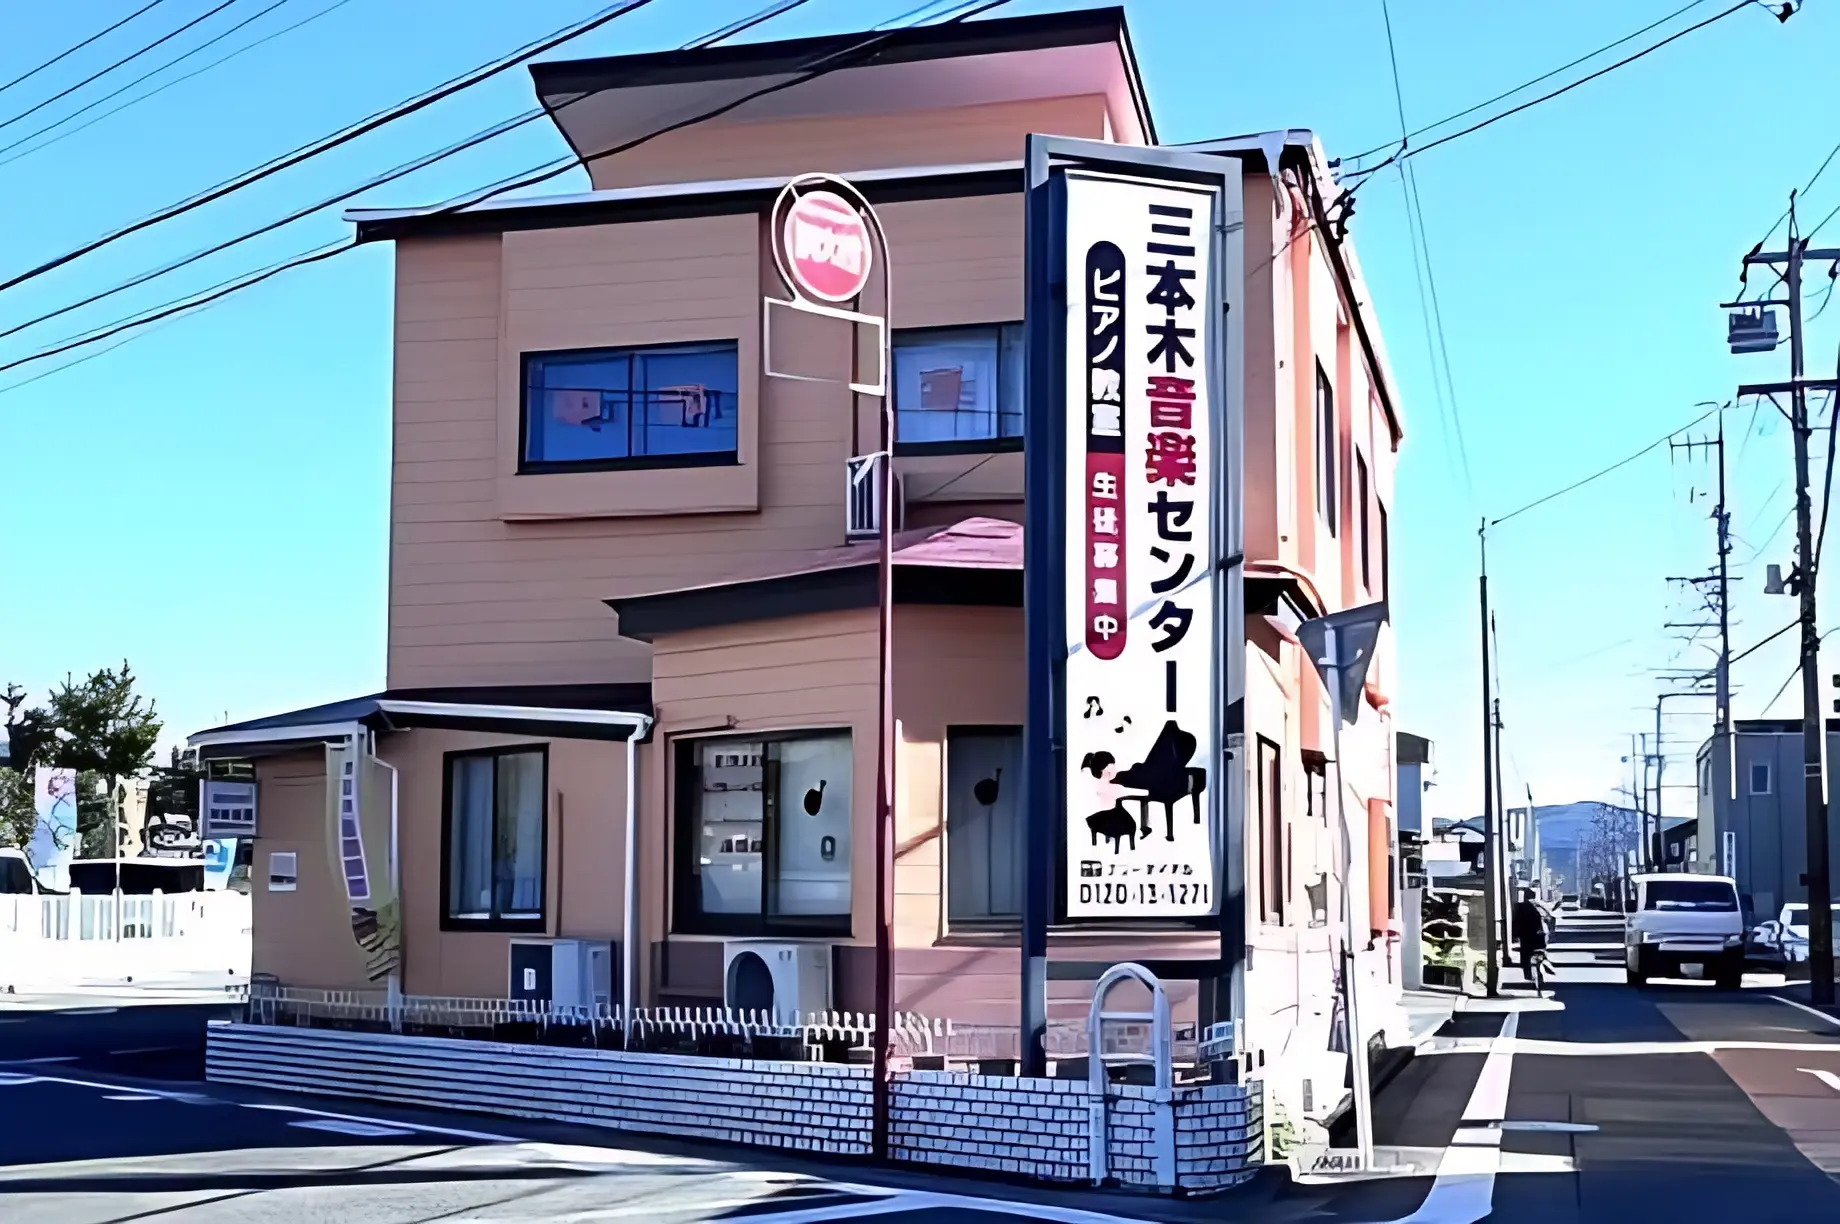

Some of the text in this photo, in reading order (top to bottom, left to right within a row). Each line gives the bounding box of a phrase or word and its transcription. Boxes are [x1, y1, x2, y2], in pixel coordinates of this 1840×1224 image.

[1146, 204, 1196, 712] 三本木音楽センター
